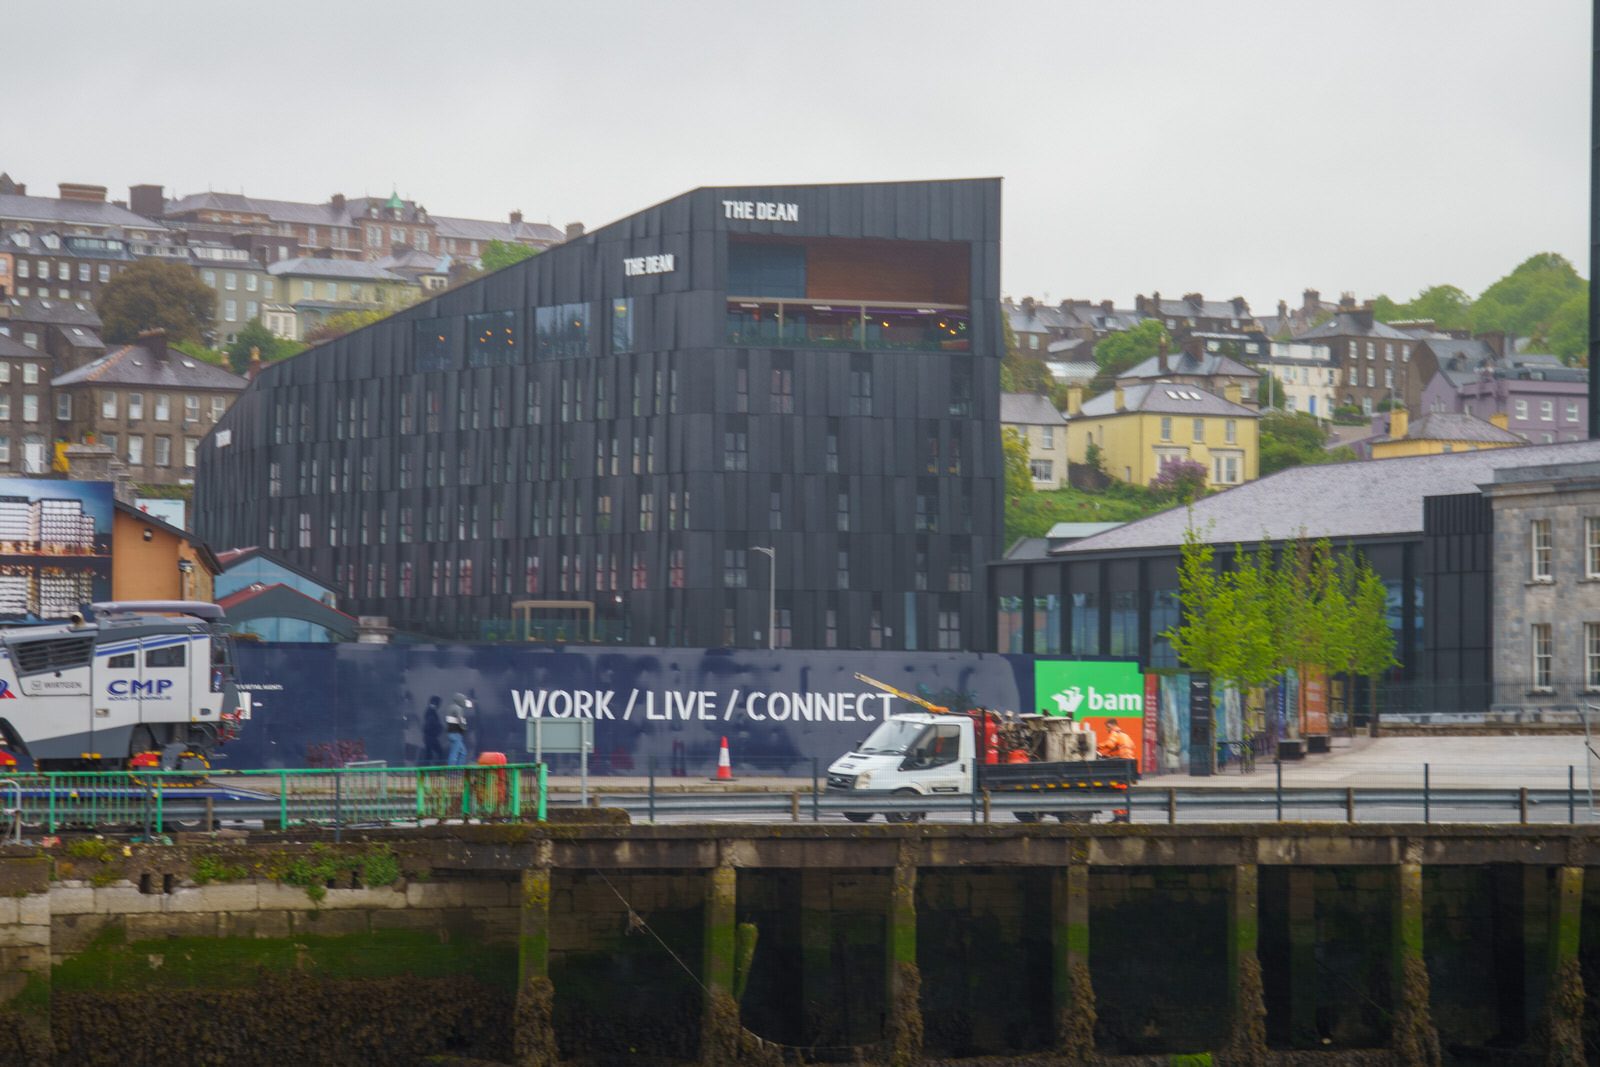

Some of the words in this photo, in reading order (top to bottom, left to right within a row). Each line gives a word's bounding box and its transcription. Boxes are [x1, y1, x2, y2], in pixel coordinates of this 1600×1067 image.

[722, 200, 755, 220] THE
[756, 202, 799, 222] DEAN
[624, 257, 646, 276] THE
[646, 254, 675, 275] DEAN
[107, 679, 173, 695] CMP
[511, 689, 615, 720] WORK
[646, 690, 717, 721] LIVE
[746, 691, 897, 721] CONNECT
[1088, 686, 1142, 711] bam
